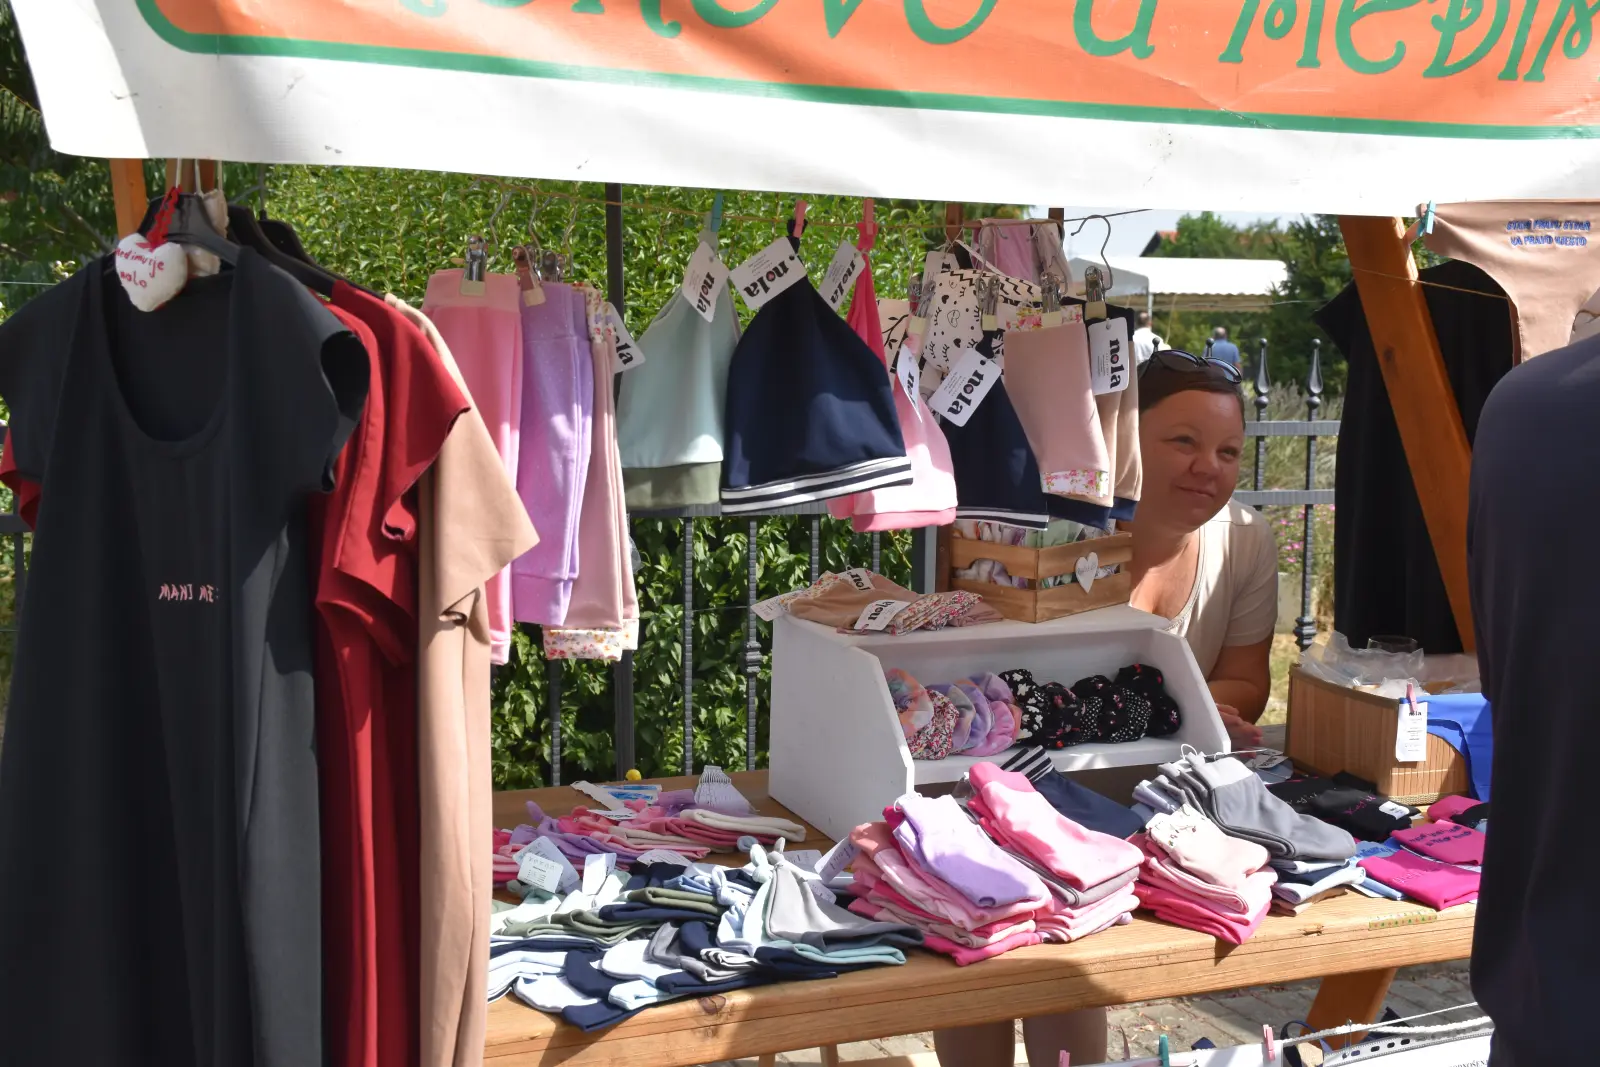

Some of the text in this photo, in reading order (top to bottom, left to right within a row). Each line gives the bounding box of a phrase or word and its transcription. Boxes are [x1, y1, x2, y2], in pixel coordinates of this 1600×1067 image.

[696, 272, 715, 314] nola
[744, 260, 790, 297] nola
[830, 260, 856, 304] nola
[1110, 338, 1125, 389] nola
[947, 369, 984, 415] nola
[850, 573, 872, 592] nol
[868, 600, 896, 621] nola
